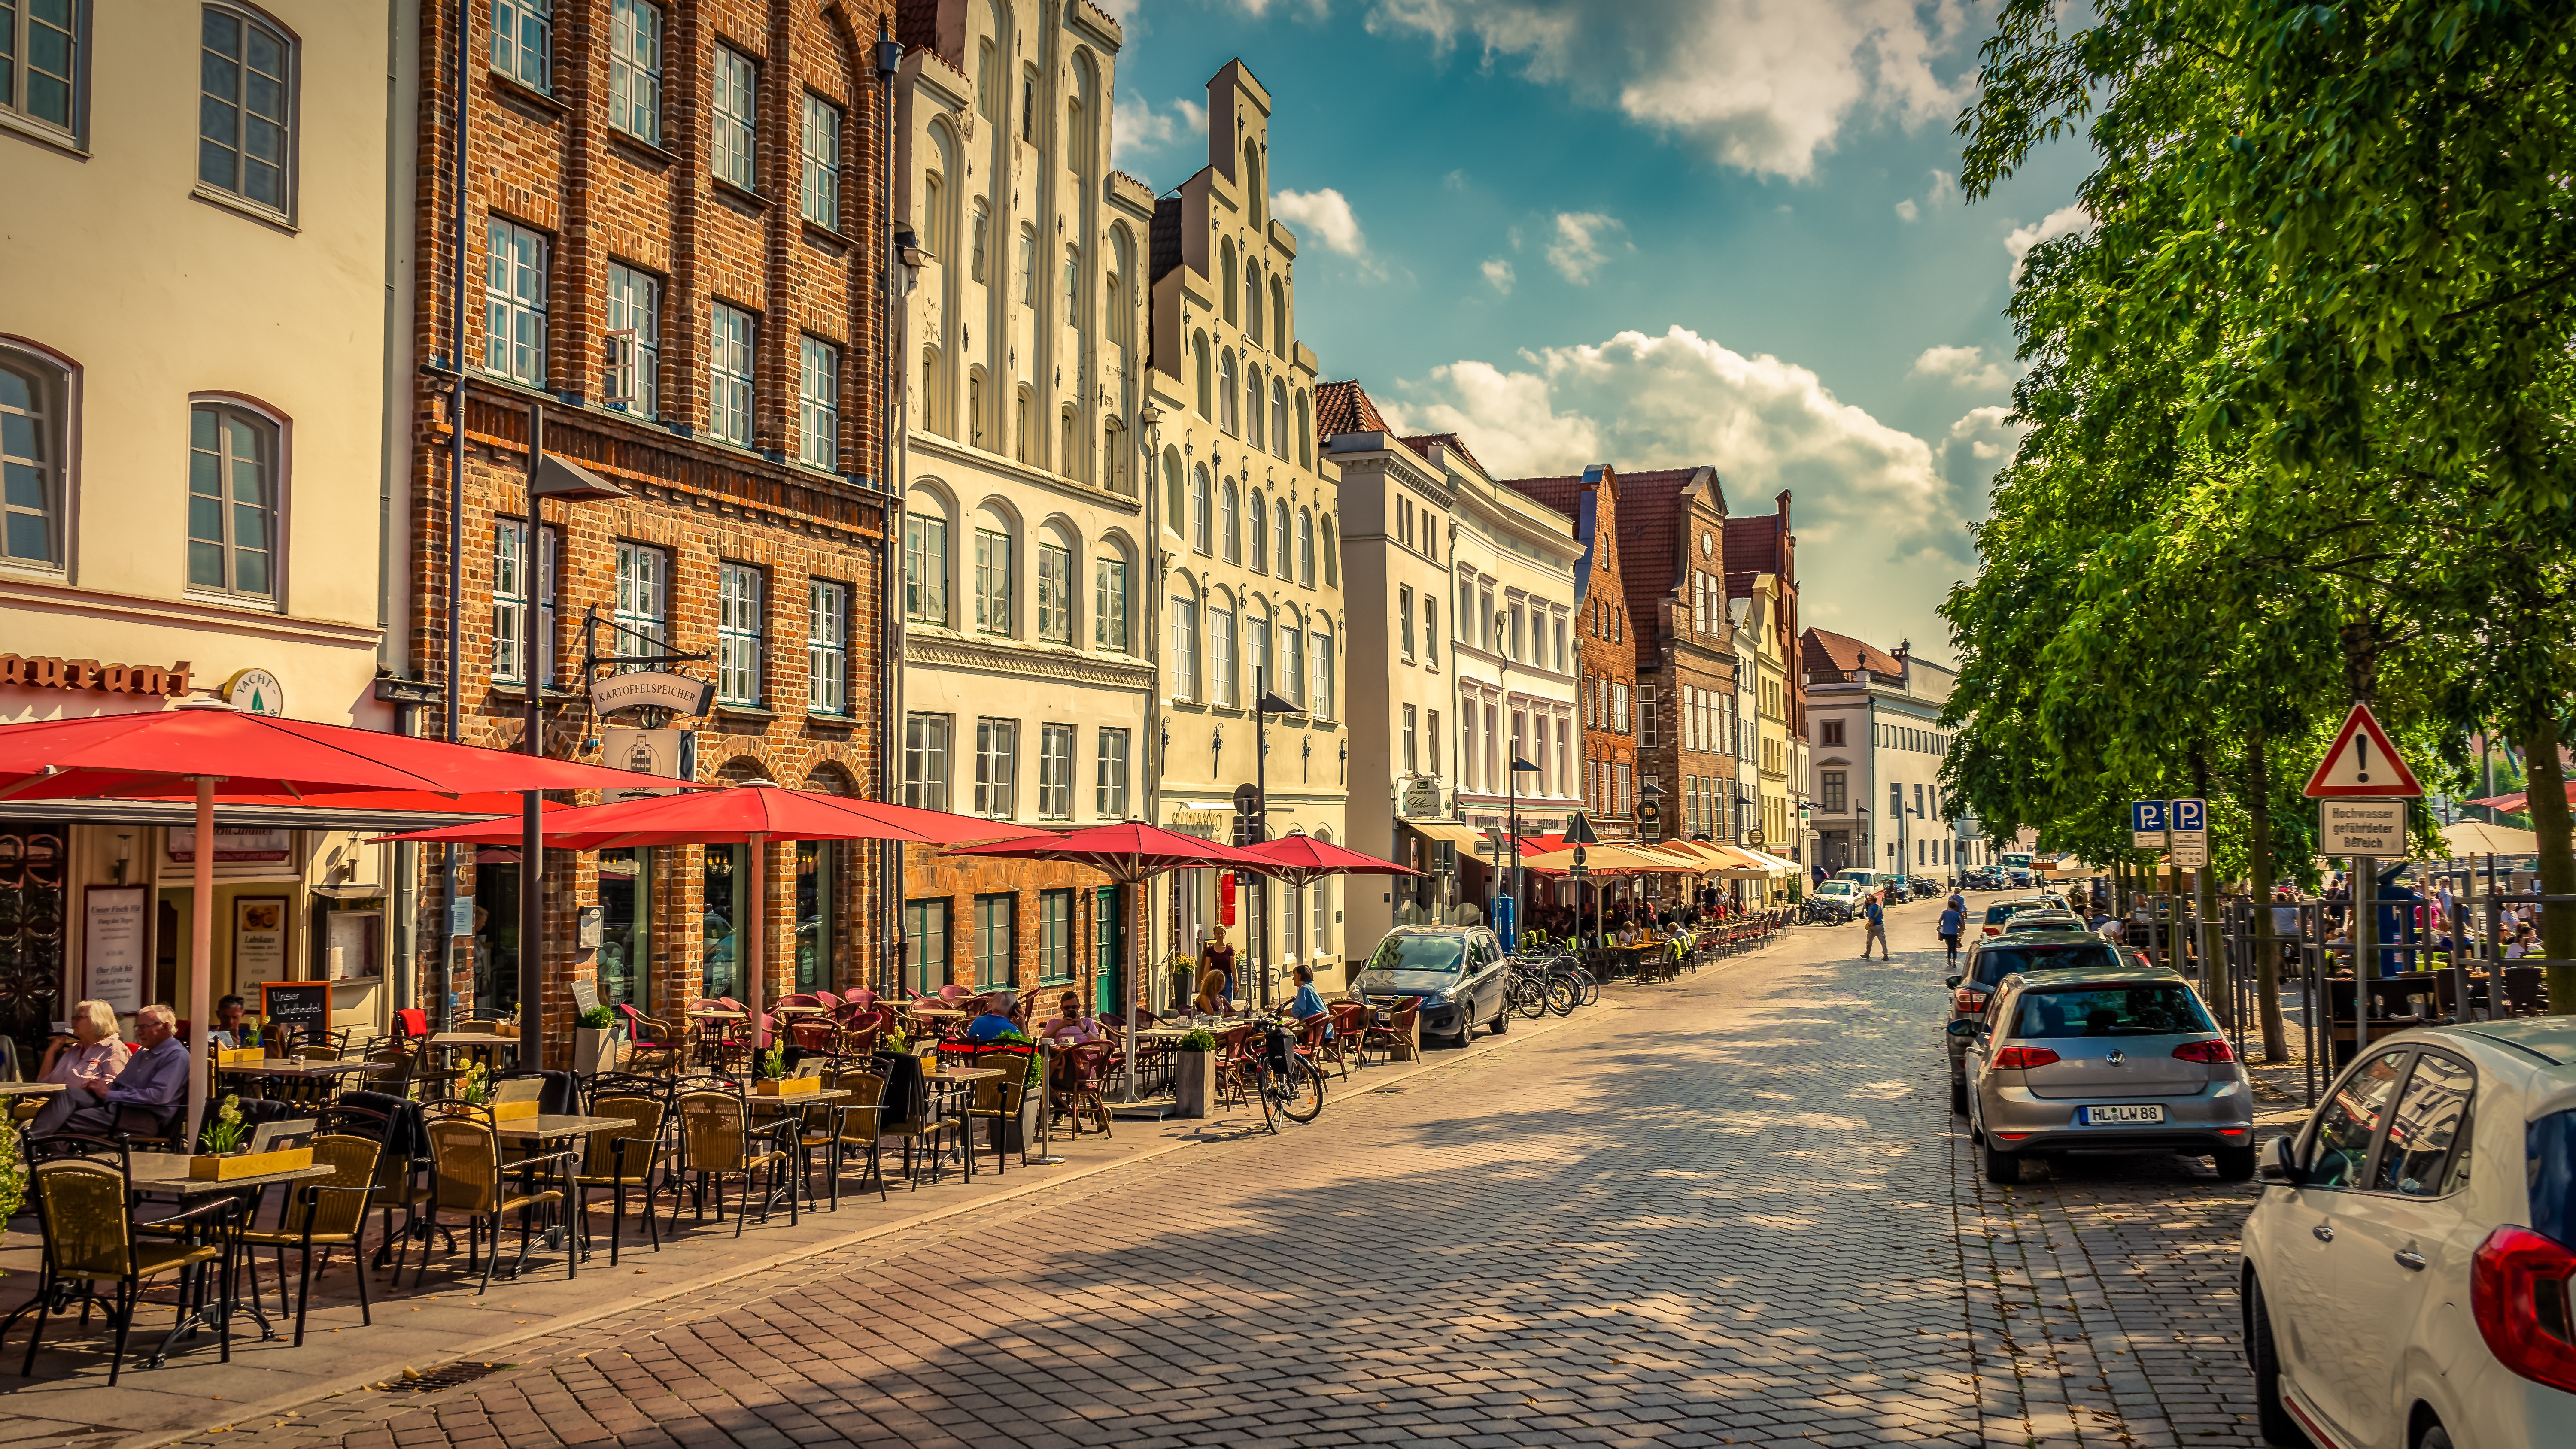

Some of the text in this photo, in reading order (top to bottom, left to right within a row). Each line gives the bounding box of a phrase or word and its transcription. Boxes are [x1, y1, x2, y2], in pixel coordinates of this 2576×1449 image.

[598, 684, 695, 703] KARTOFFELSPEICHER
[2140, 806, 2157, 828] P
[2180, 803, 2198, 828] P
[2333, 808, 2394, 818] Hochwasser
[2333, 823, 2394, 835] gefährdeter
[2345, 837, 2382, 847] Bereich
[459, 866, 467, 881] 6
[273, 991, 300, 1001] Unser
[2092, 1107, 2157, 1121] HL LW 88
